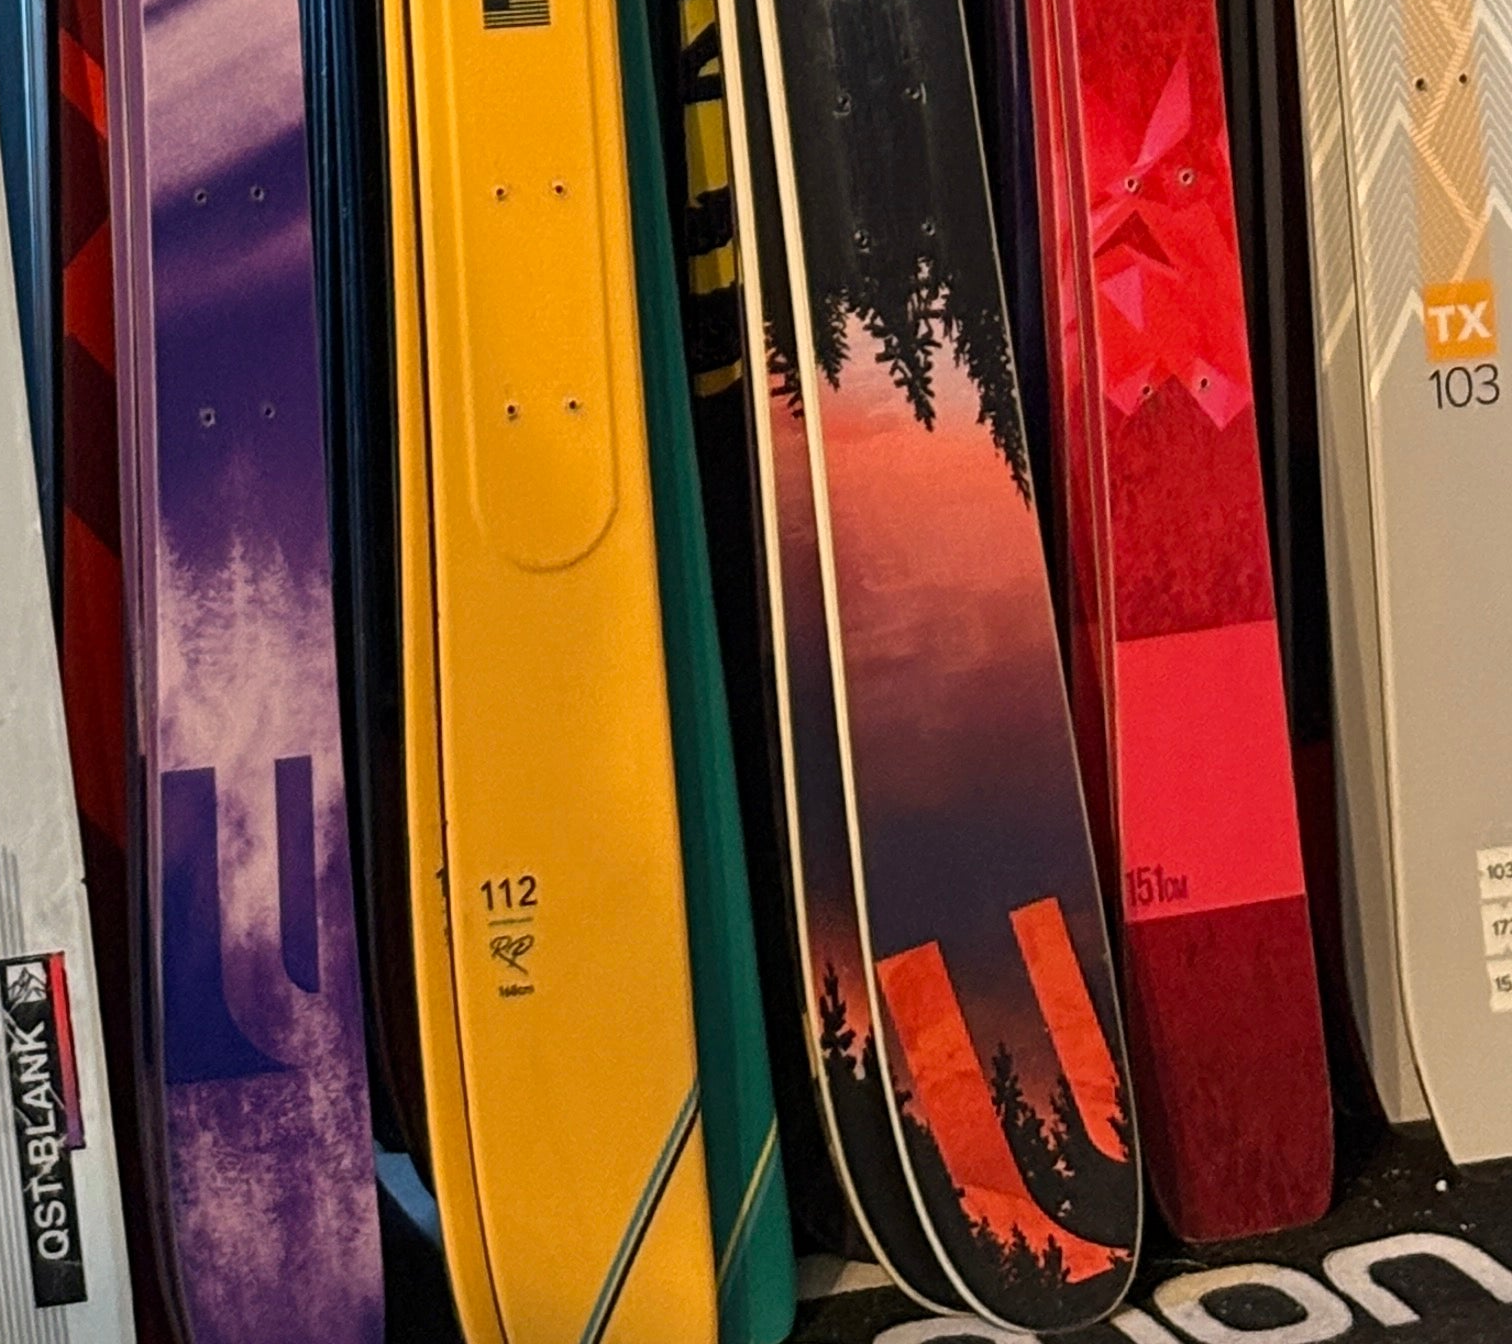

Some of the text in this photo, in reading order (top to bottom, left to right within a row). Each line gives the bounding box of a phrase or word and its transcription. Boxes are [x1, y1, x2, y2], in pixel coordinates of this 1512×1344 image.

[1428, 300, 1492, 343] TX
[1428, 363, 1500, 409] 103
[481, 875, 538, 911] 112
[1492, 919, 1512, 936] 17
[17, 1020, 71, 1261] QST BLANK
